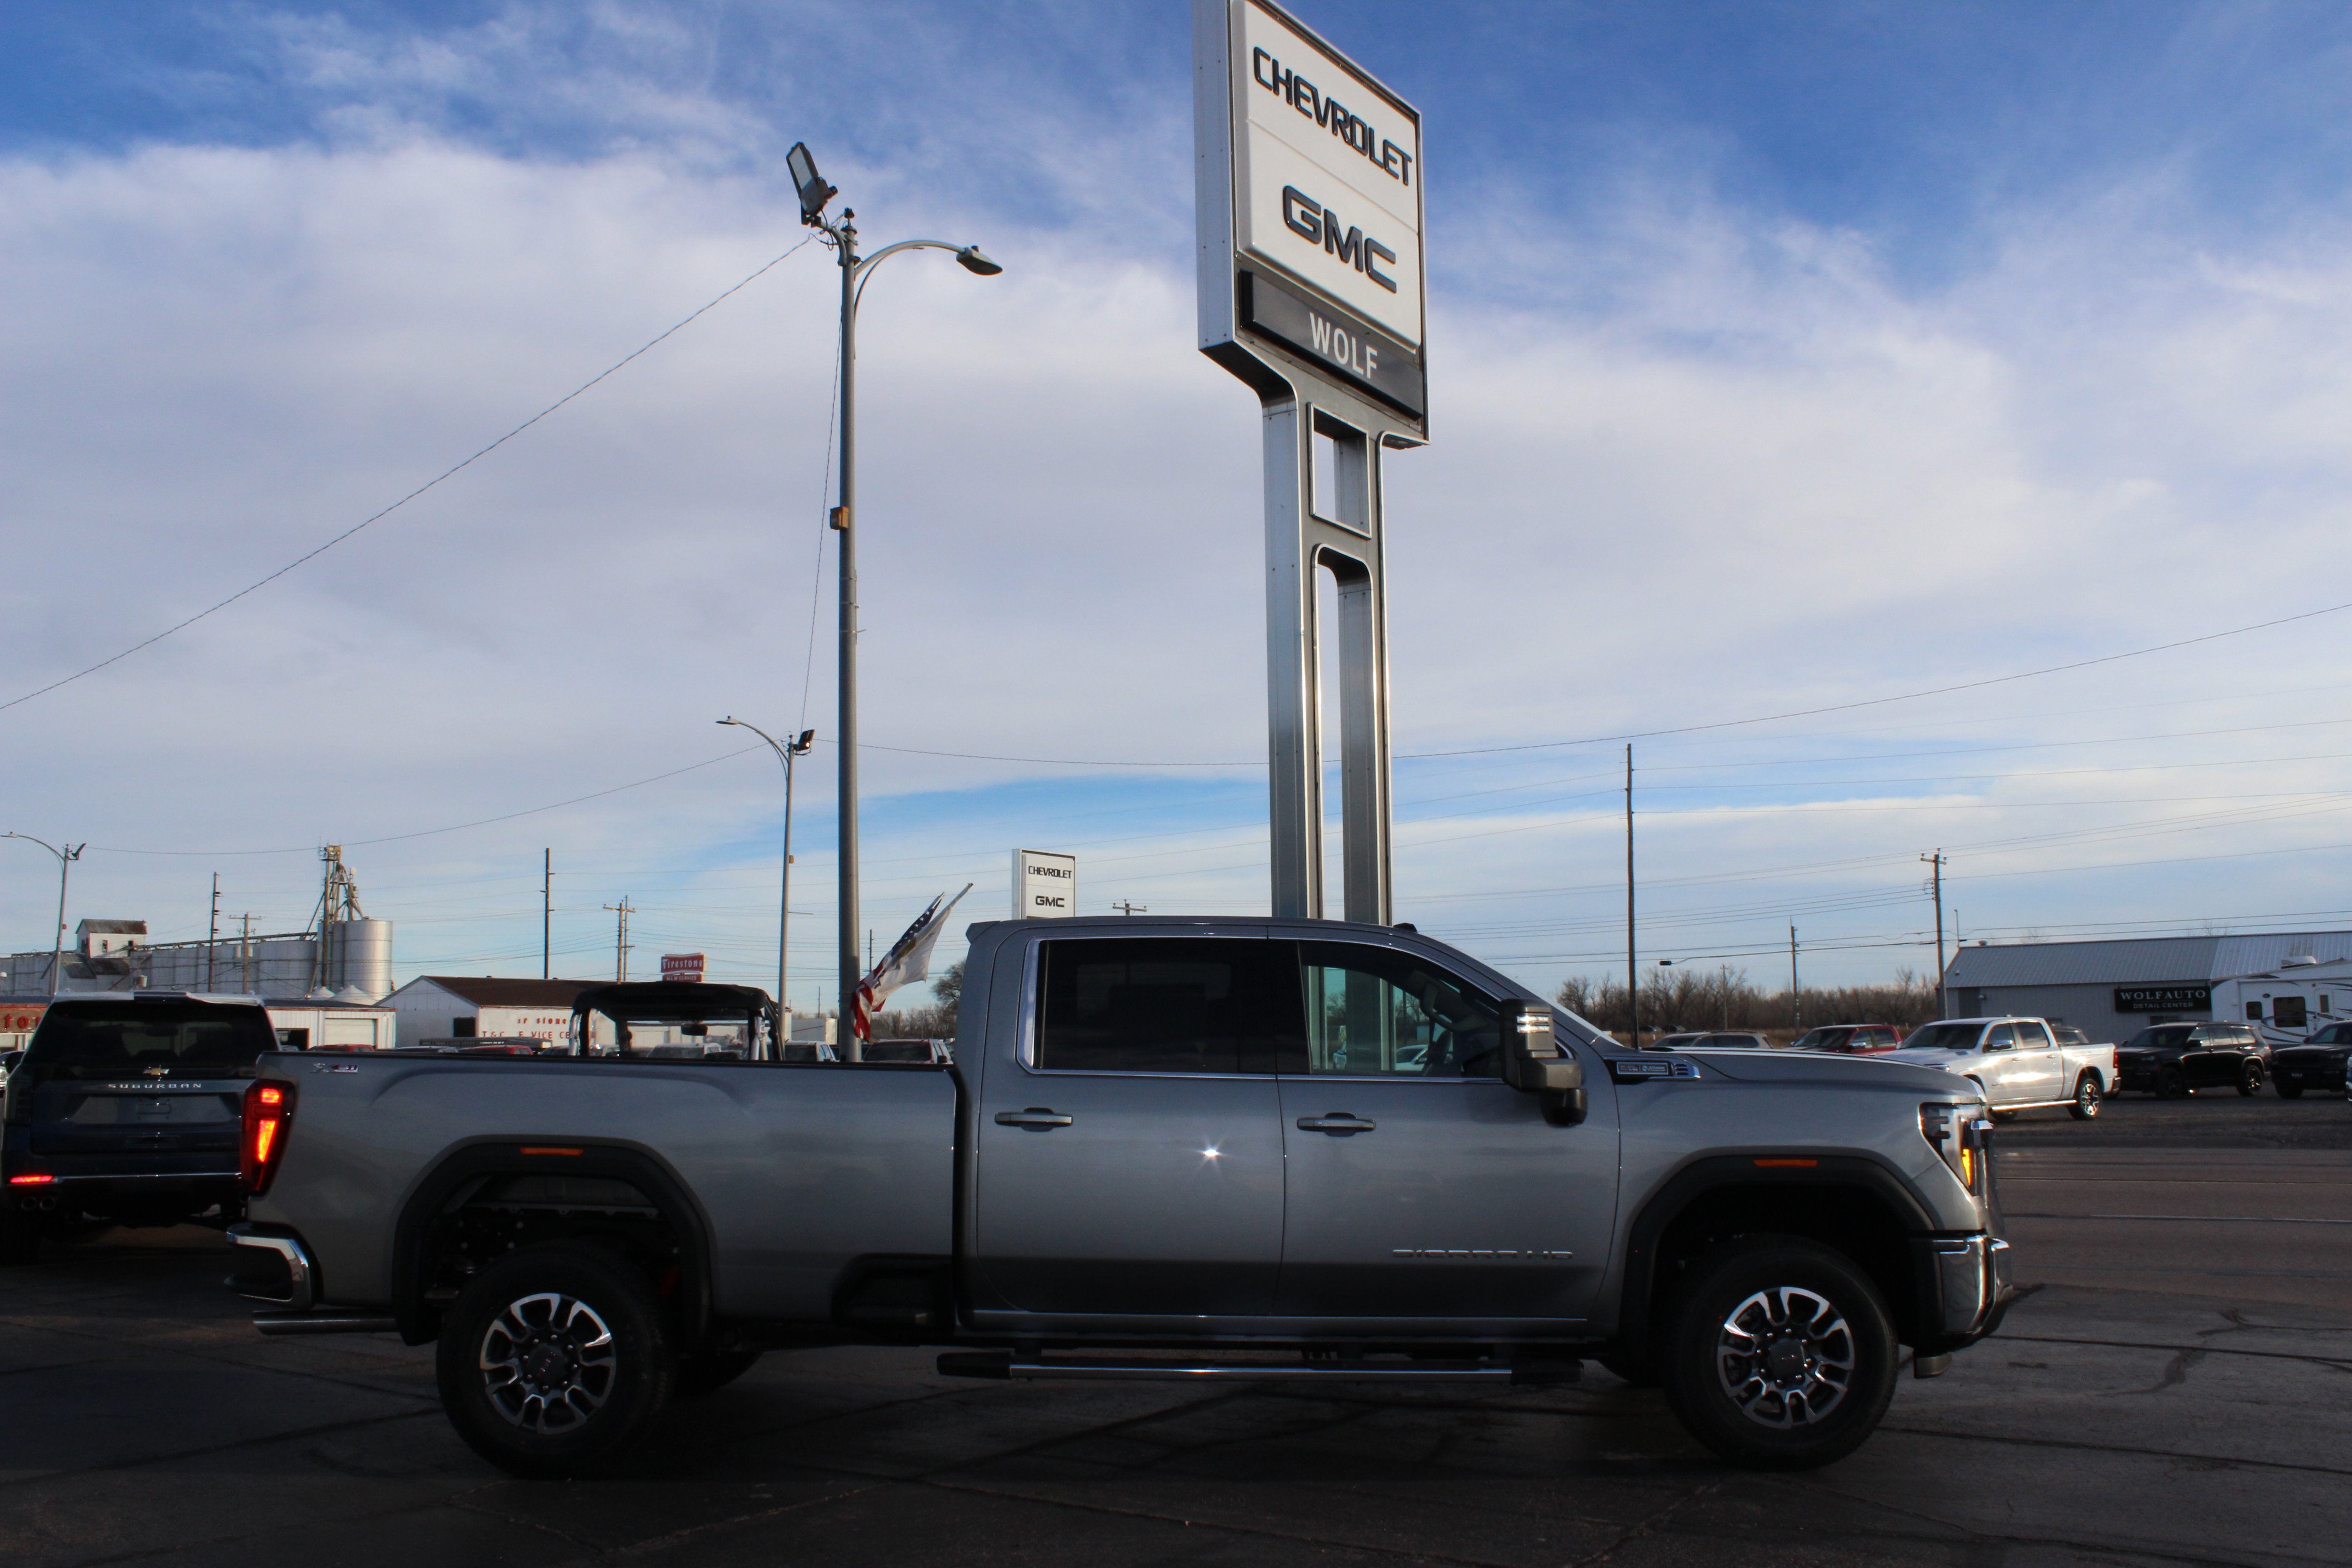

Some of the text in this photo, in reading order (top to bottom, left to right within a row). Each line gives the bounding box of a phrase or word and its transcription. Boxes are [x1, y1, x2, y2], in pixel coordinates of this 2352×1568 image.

[1253, 46, 1412, 186] CHEVROLET
[1282, 185, 1396, 294] GMC
[1309, 311, 1378, 380] WOLF
[1028, 865, 1072, 879] CHEVROLET
[1035, 895, 1065, 907] GMC
[662, 958, 703, 970] Firestone
